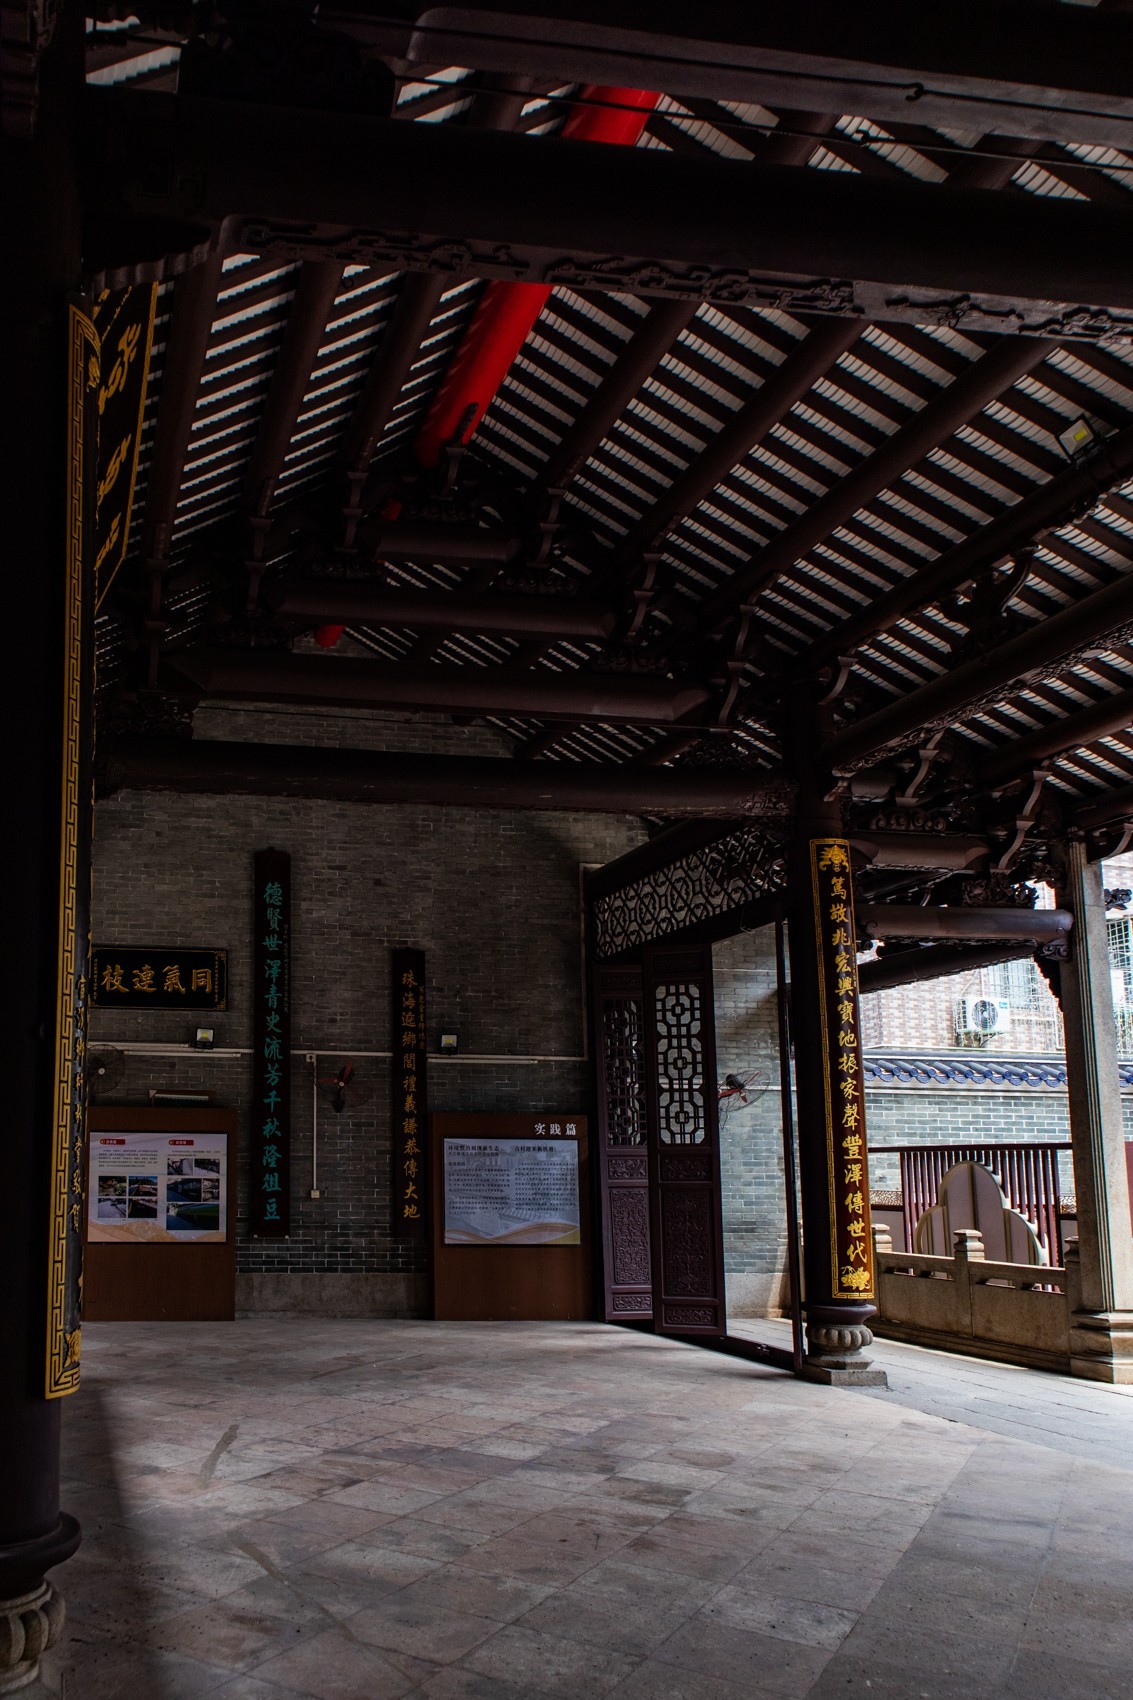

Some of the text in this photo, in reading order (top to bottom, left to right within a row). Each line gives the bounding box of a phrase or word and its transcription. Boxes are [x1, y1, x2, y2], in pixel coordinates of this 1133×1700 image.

[100, 963, 213, 994] 同氣連枝
[534, 1122, 577, 1136] 实践篇
